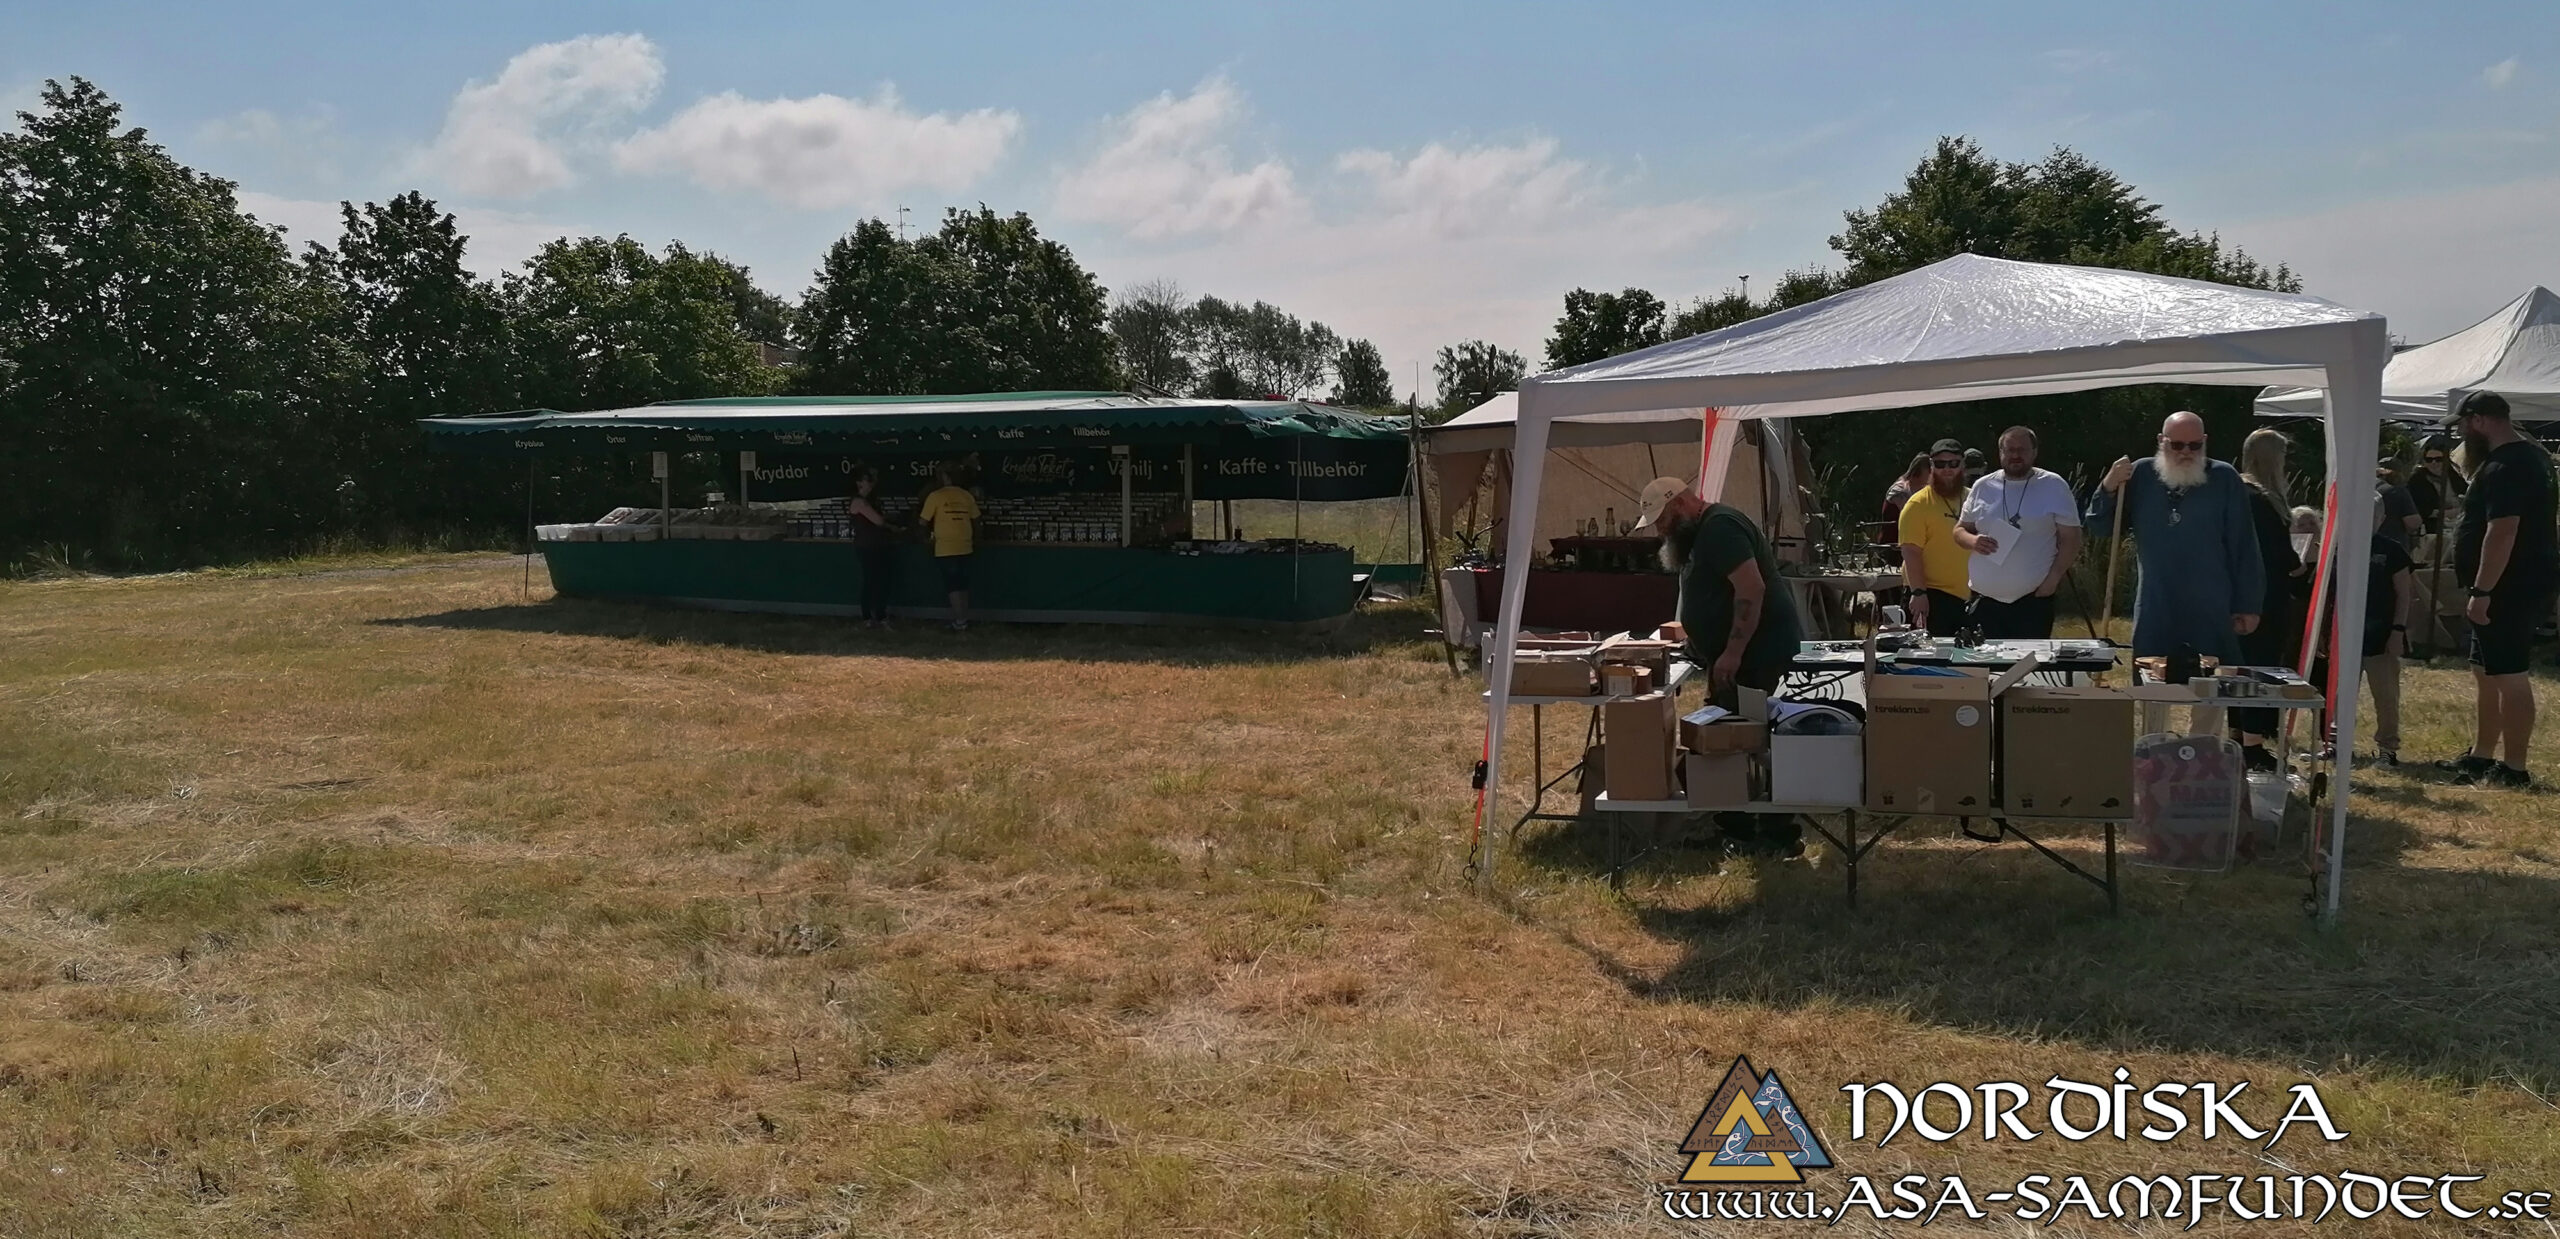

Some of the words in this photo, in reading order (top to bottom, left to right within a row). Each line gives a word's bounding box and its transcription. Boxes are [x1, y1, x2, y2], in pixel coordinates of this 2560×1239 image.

[998, 429, 1025, 440] Kaffe
[753, 465, 809, 484] Kryddor
[1218, 457, 1268, 476] Kaffe
[1287, 460, 1367, 478] Tillbehör
